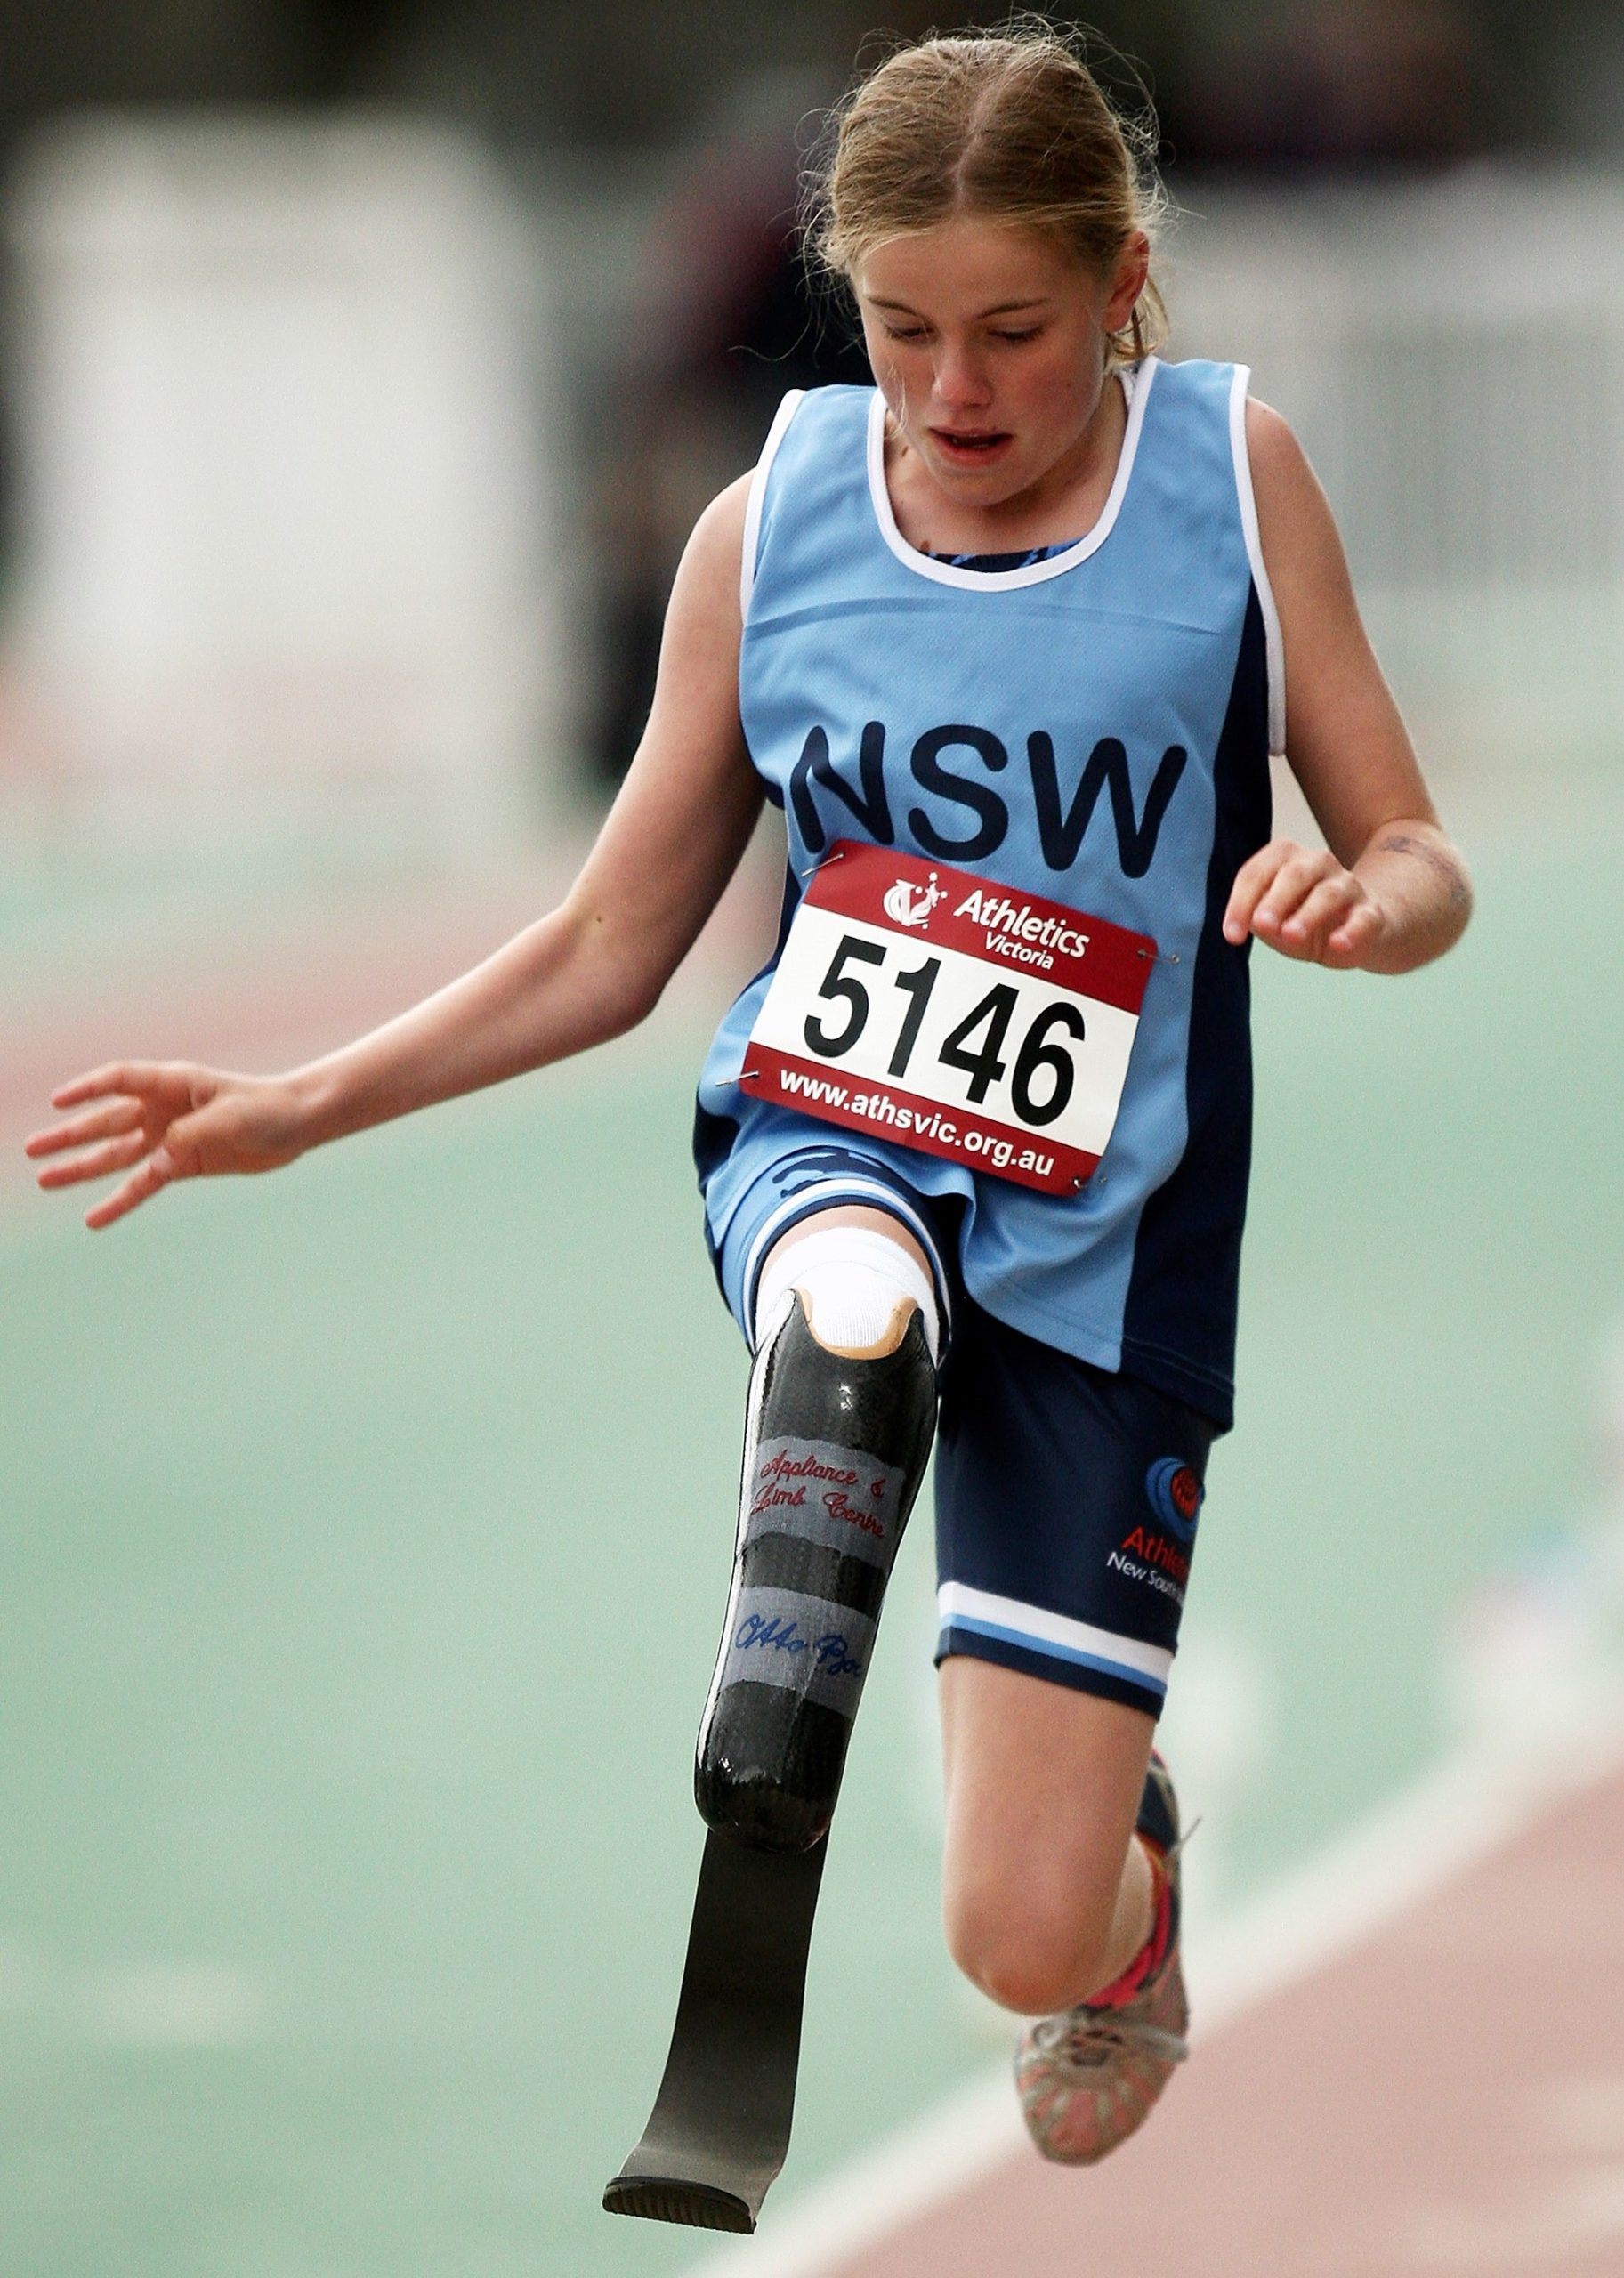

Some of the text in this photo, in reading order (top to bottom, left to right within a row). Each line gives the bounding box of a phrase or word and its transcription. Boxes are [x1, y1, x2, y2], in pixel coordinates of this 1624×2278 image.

[789, 721, 1187, 878] NSW
[954, 890, 1090, 958] Athletics
[985, 932, 1054, 970] Victoria
[804, 935, 1086, 1127] 5146
[780, 1070, 1054, 1177] www.athsvic.org.au
[761, 1449, 859, 1485] Appliance
[751, 1482, 885, 1538] Limb Centre
[1106, 1551, 1148, 1581] New
[735, 1614, 809, 1652] Otto
